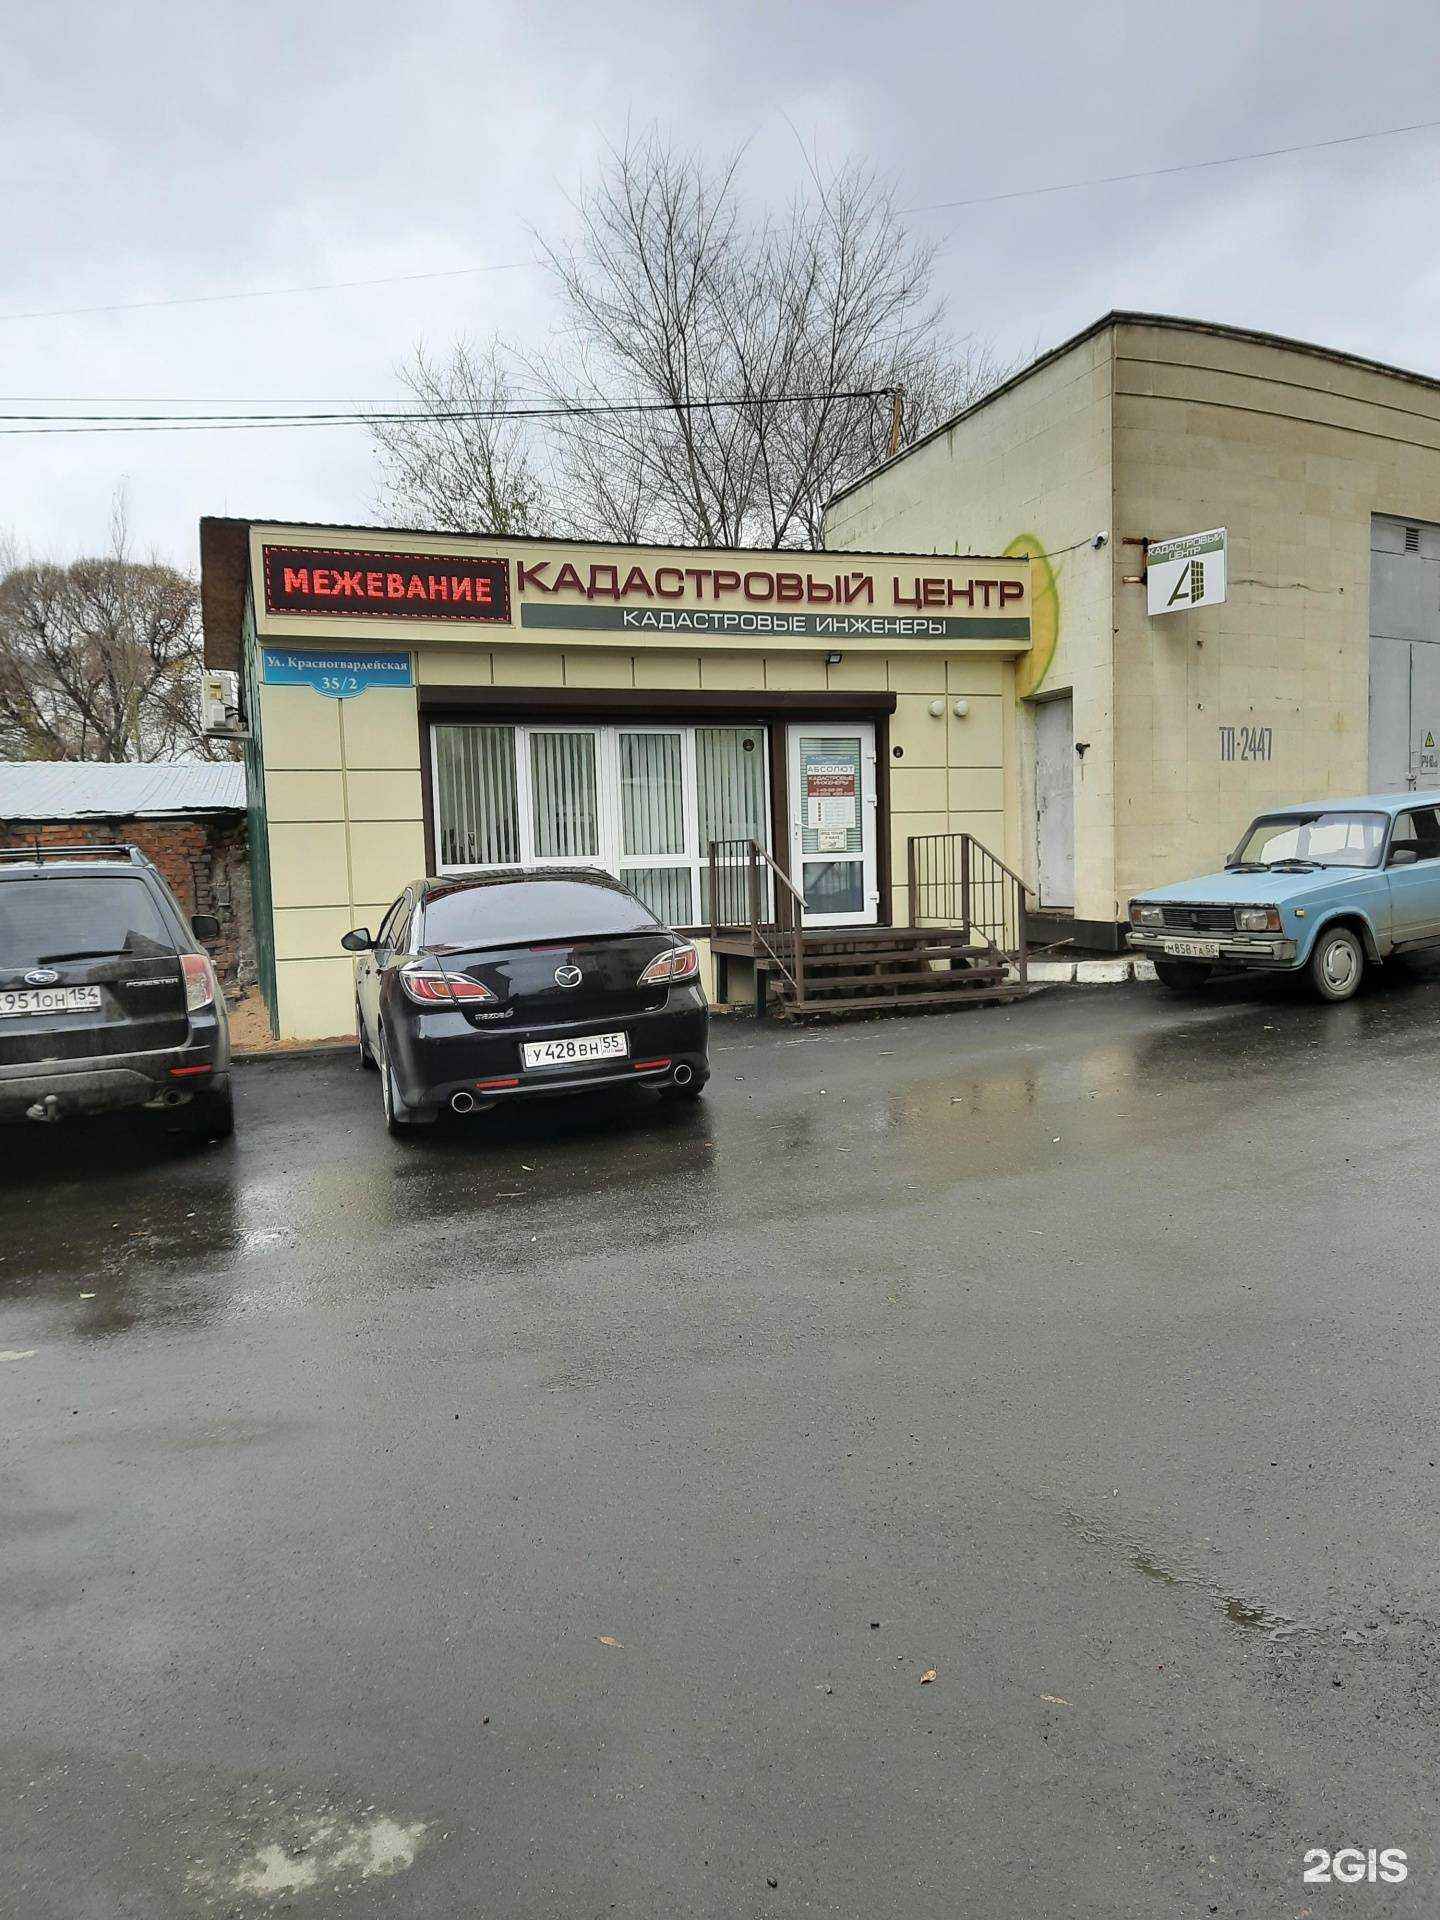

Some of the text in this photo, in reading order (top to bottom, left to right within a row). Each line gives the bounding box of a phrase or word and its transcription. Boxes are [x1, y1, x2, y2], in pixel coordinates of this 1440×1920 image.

[1168, 547, 1201, 560] ЦЕНТР
[283, 567, 493, 603] МЕЖЕВАНИЕ
[516, 560, 1025, 609] КАДАСТРОВЫЙ ЦЕНТР
[623, 610, 947, 635] КАДАСТРОВЫЕ ИНЖЕНЕРЫ
[267, 656, 408, 672] Ул. Красногвардейская
[321, 677, 358, 690] 35/2
